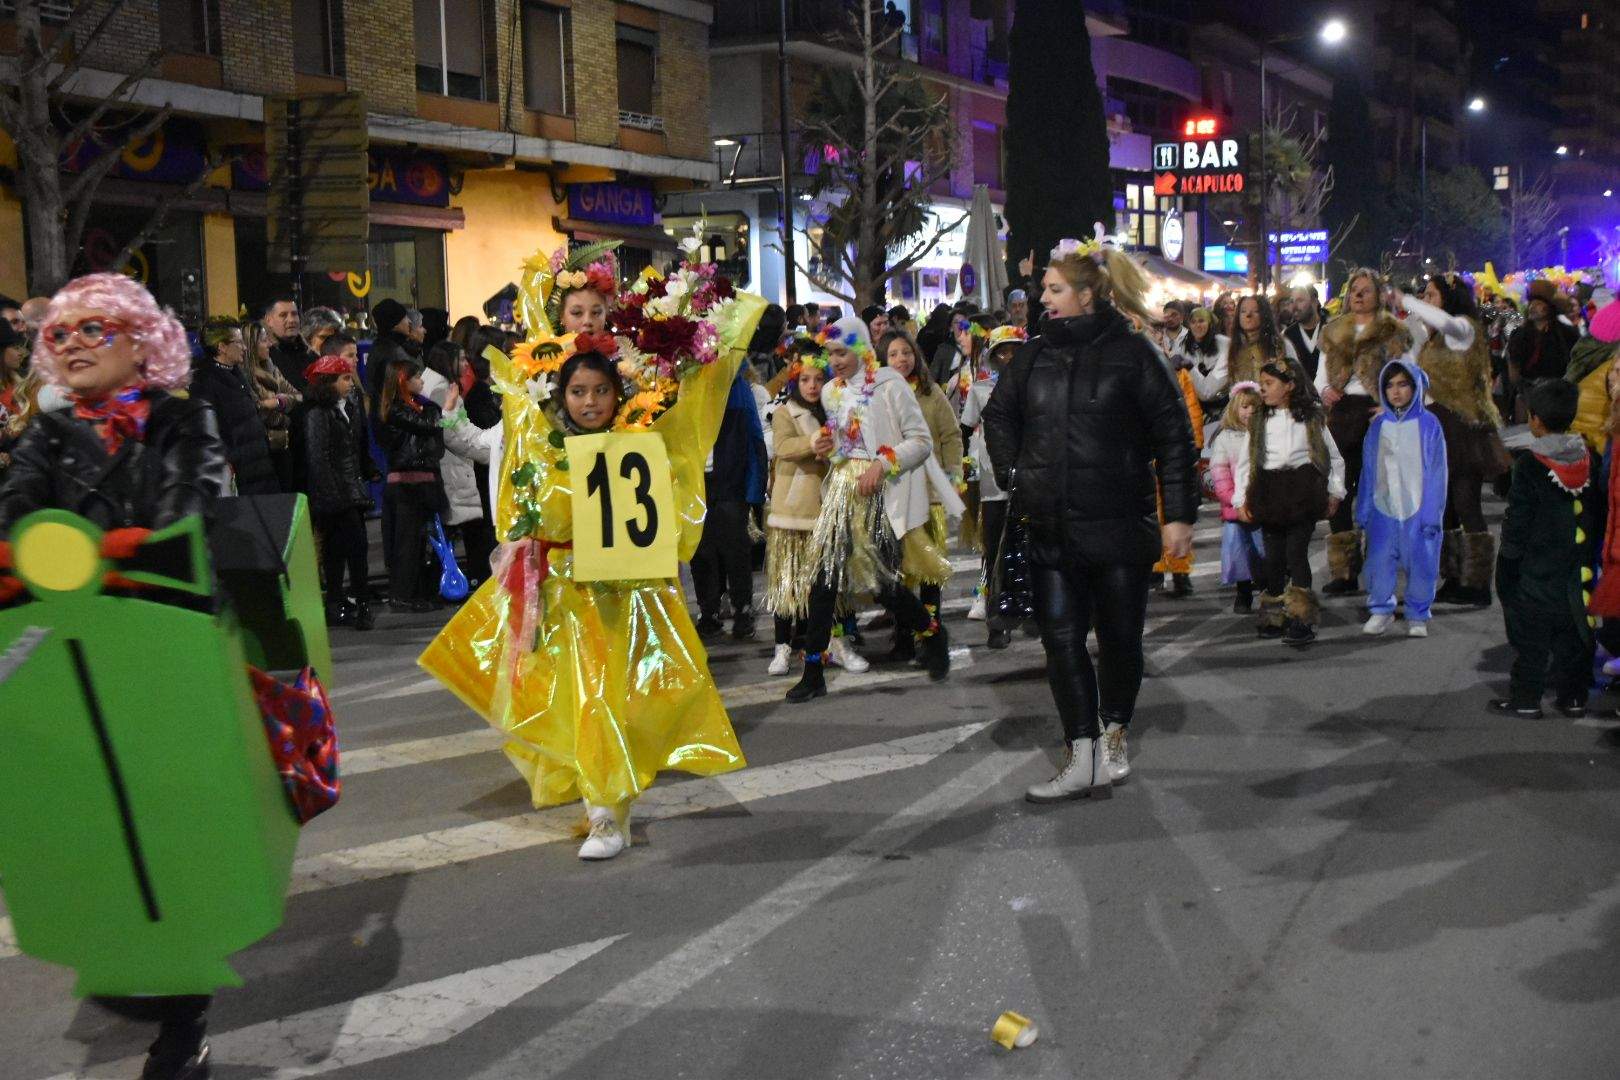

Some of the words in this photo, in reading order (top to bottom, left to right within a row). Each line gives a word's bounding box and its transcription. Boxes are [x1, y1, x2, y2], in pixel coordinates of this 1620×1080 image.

[1183, 140, 1239, 169] BAR
[1180, 173, 1243, 193] ACAPULCO
[581, 184, 645, 216] GANGA
[586, 451, 659, 549] 13
